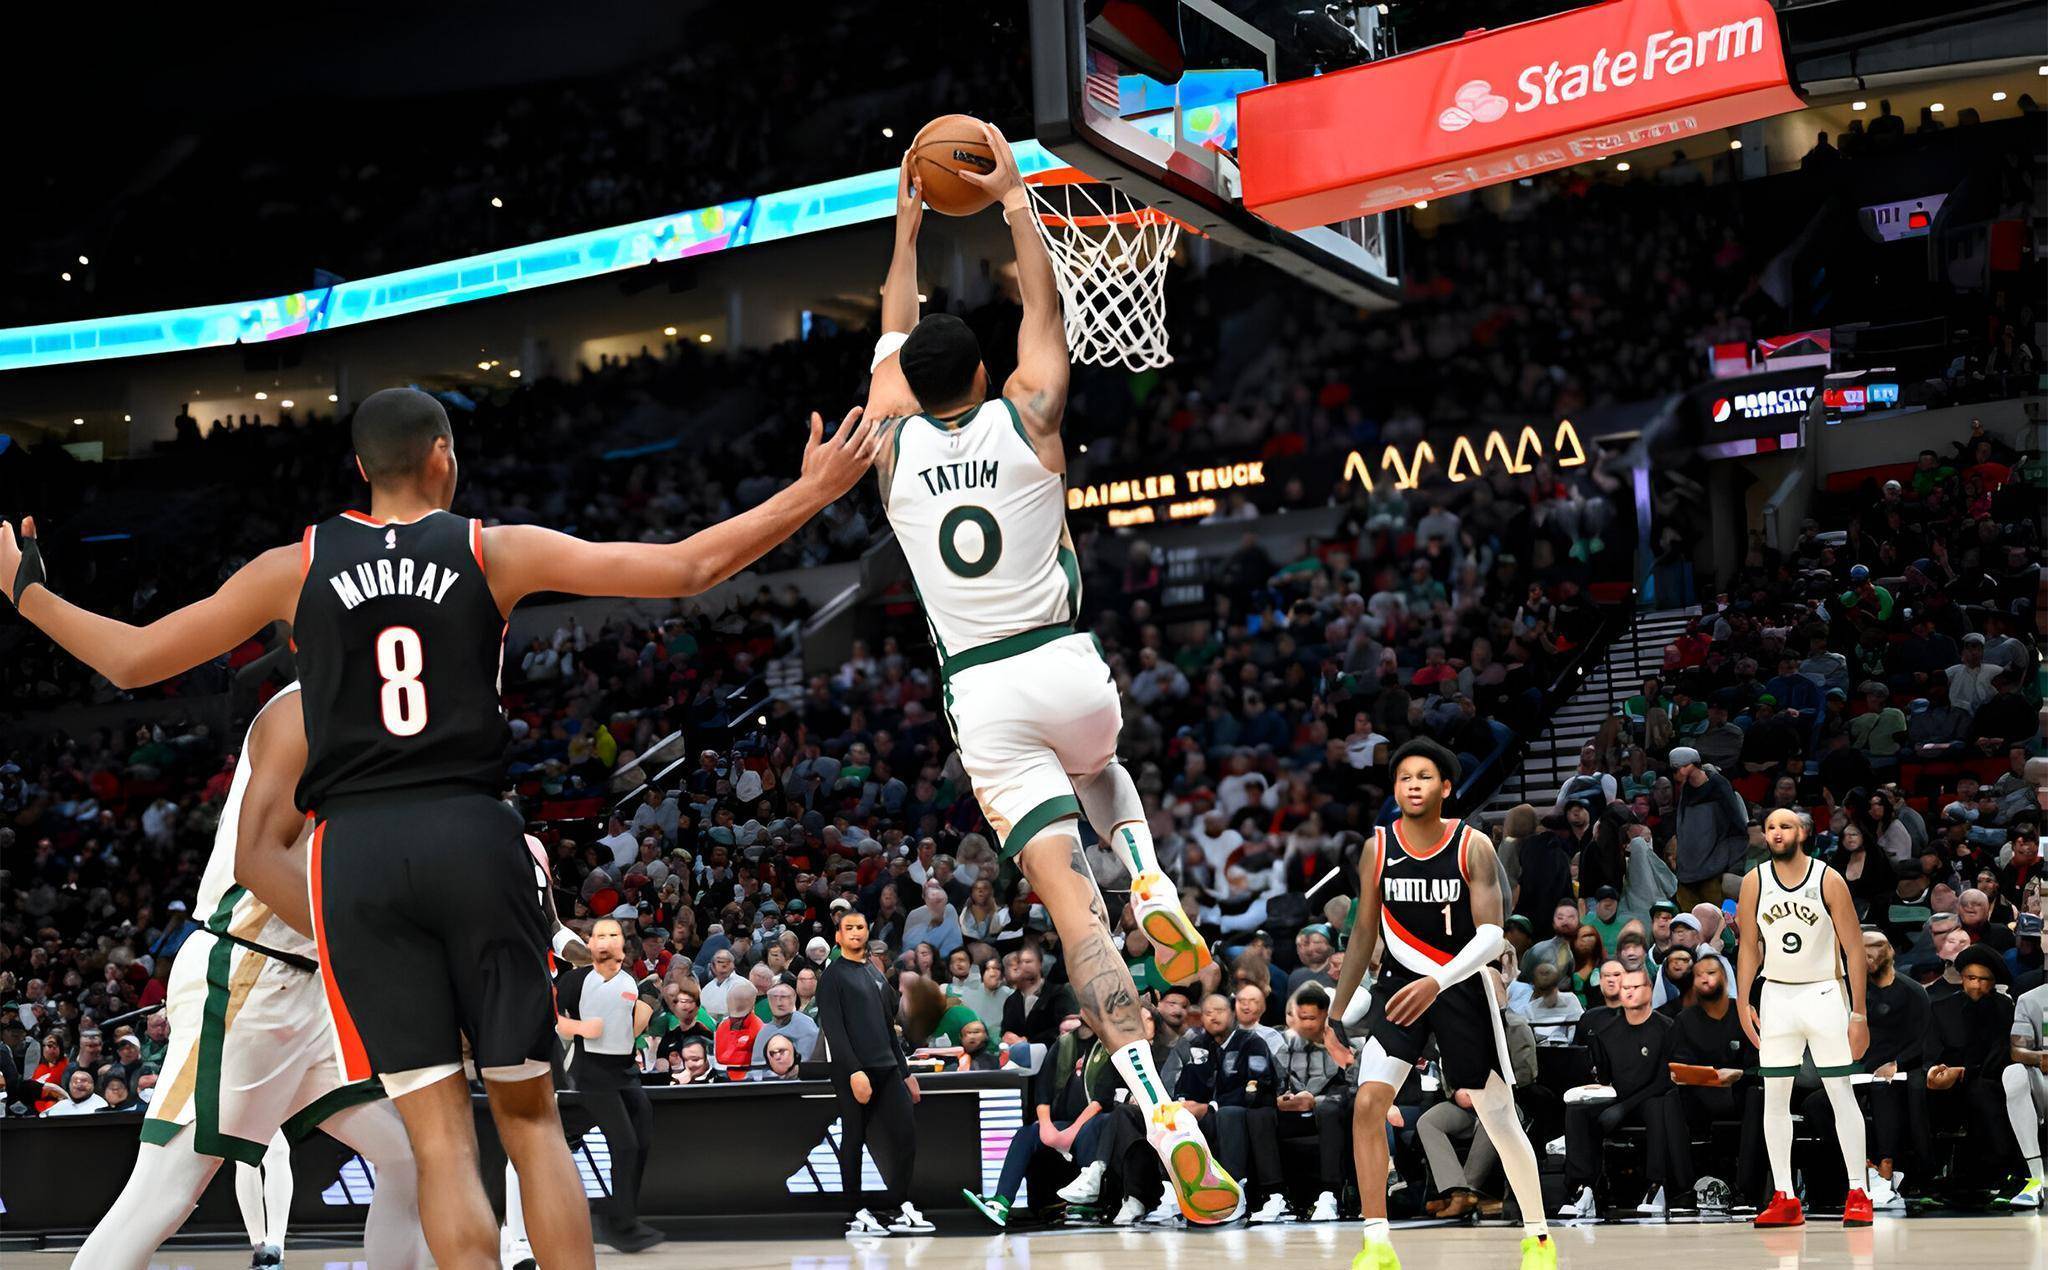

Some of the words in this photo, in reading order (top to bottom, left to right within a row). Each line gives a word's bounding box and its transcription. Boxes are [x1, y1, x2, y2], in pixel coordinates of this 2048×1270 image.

[918, 460, 999, 496] TATUM
[1067, 474, 1176, 510] DAIMLER
[1186, 461, 1265, 493] TRUCK
[939, 505, 1002, 578] 0
[329, 558, 460, 610] MURRAY
[376, 625, 429, 737] 8
[1441, 903, 1452, 936] 1
[1782, 932, 1802, 953] 9
